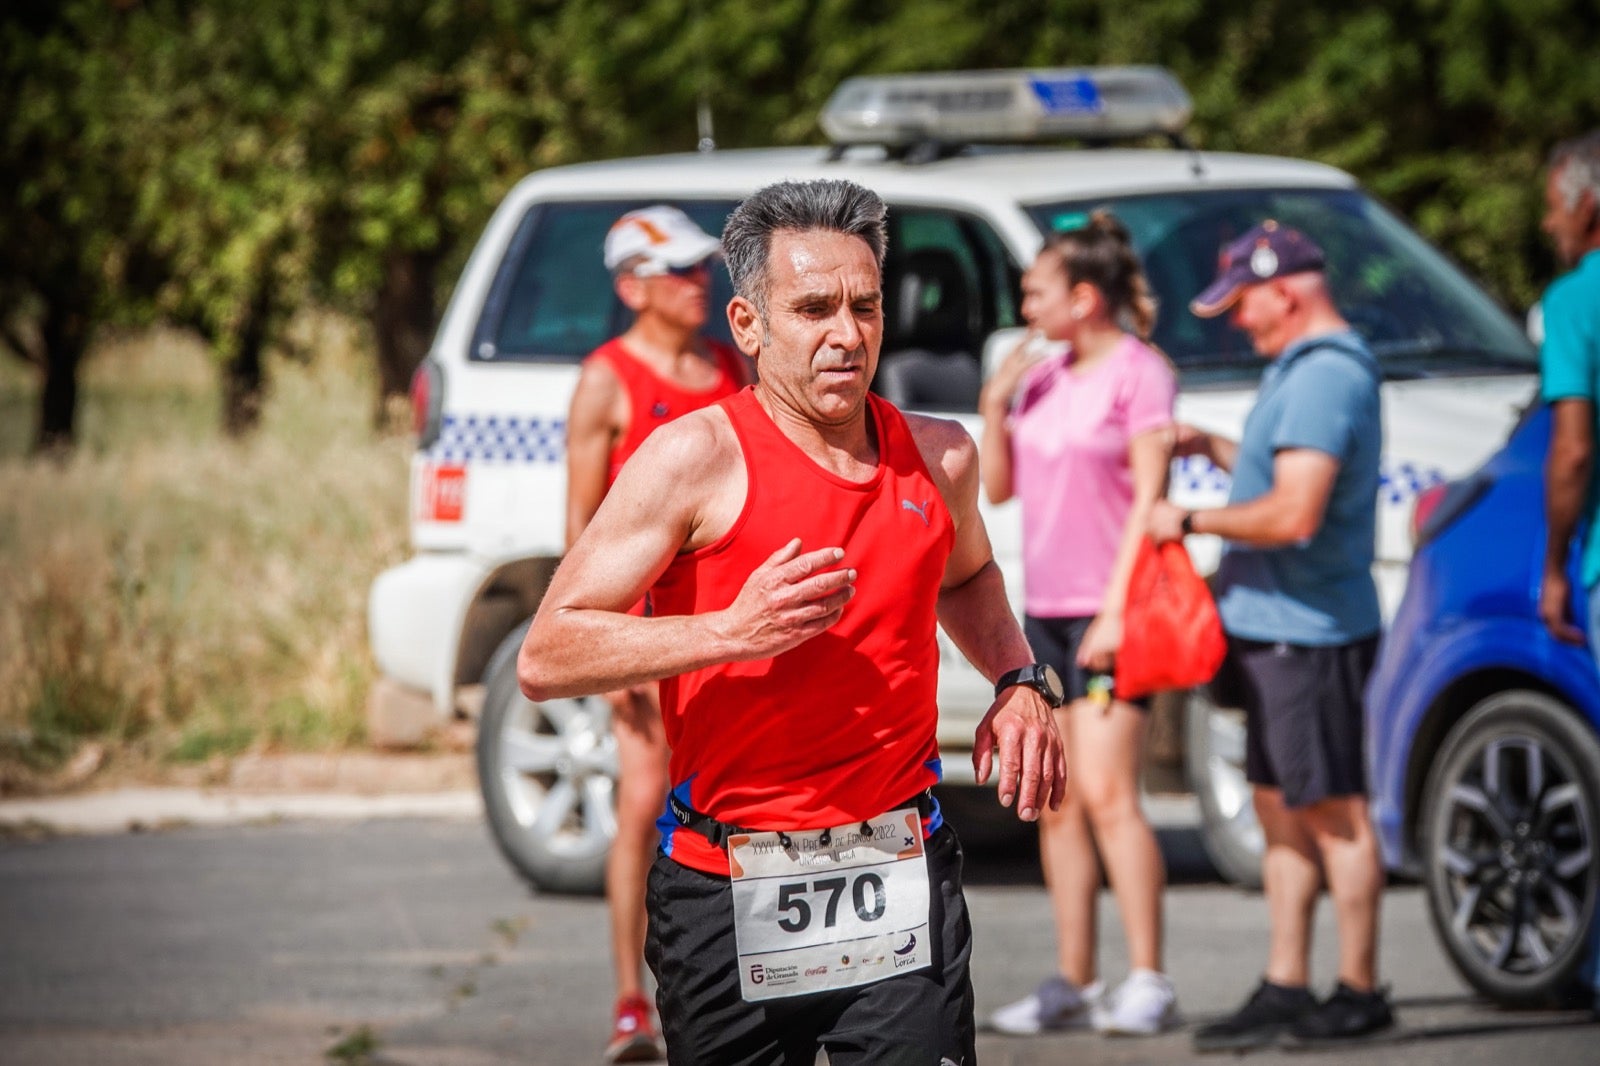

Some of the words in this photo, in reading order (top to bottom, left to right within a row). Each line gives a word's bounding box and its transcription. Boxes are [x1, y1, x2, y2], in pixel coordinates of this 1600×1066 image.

[752, 840, 774, 855] XXXV
[873, 824, 896, 840] 2022
[778, 873, 886, 932] 570
